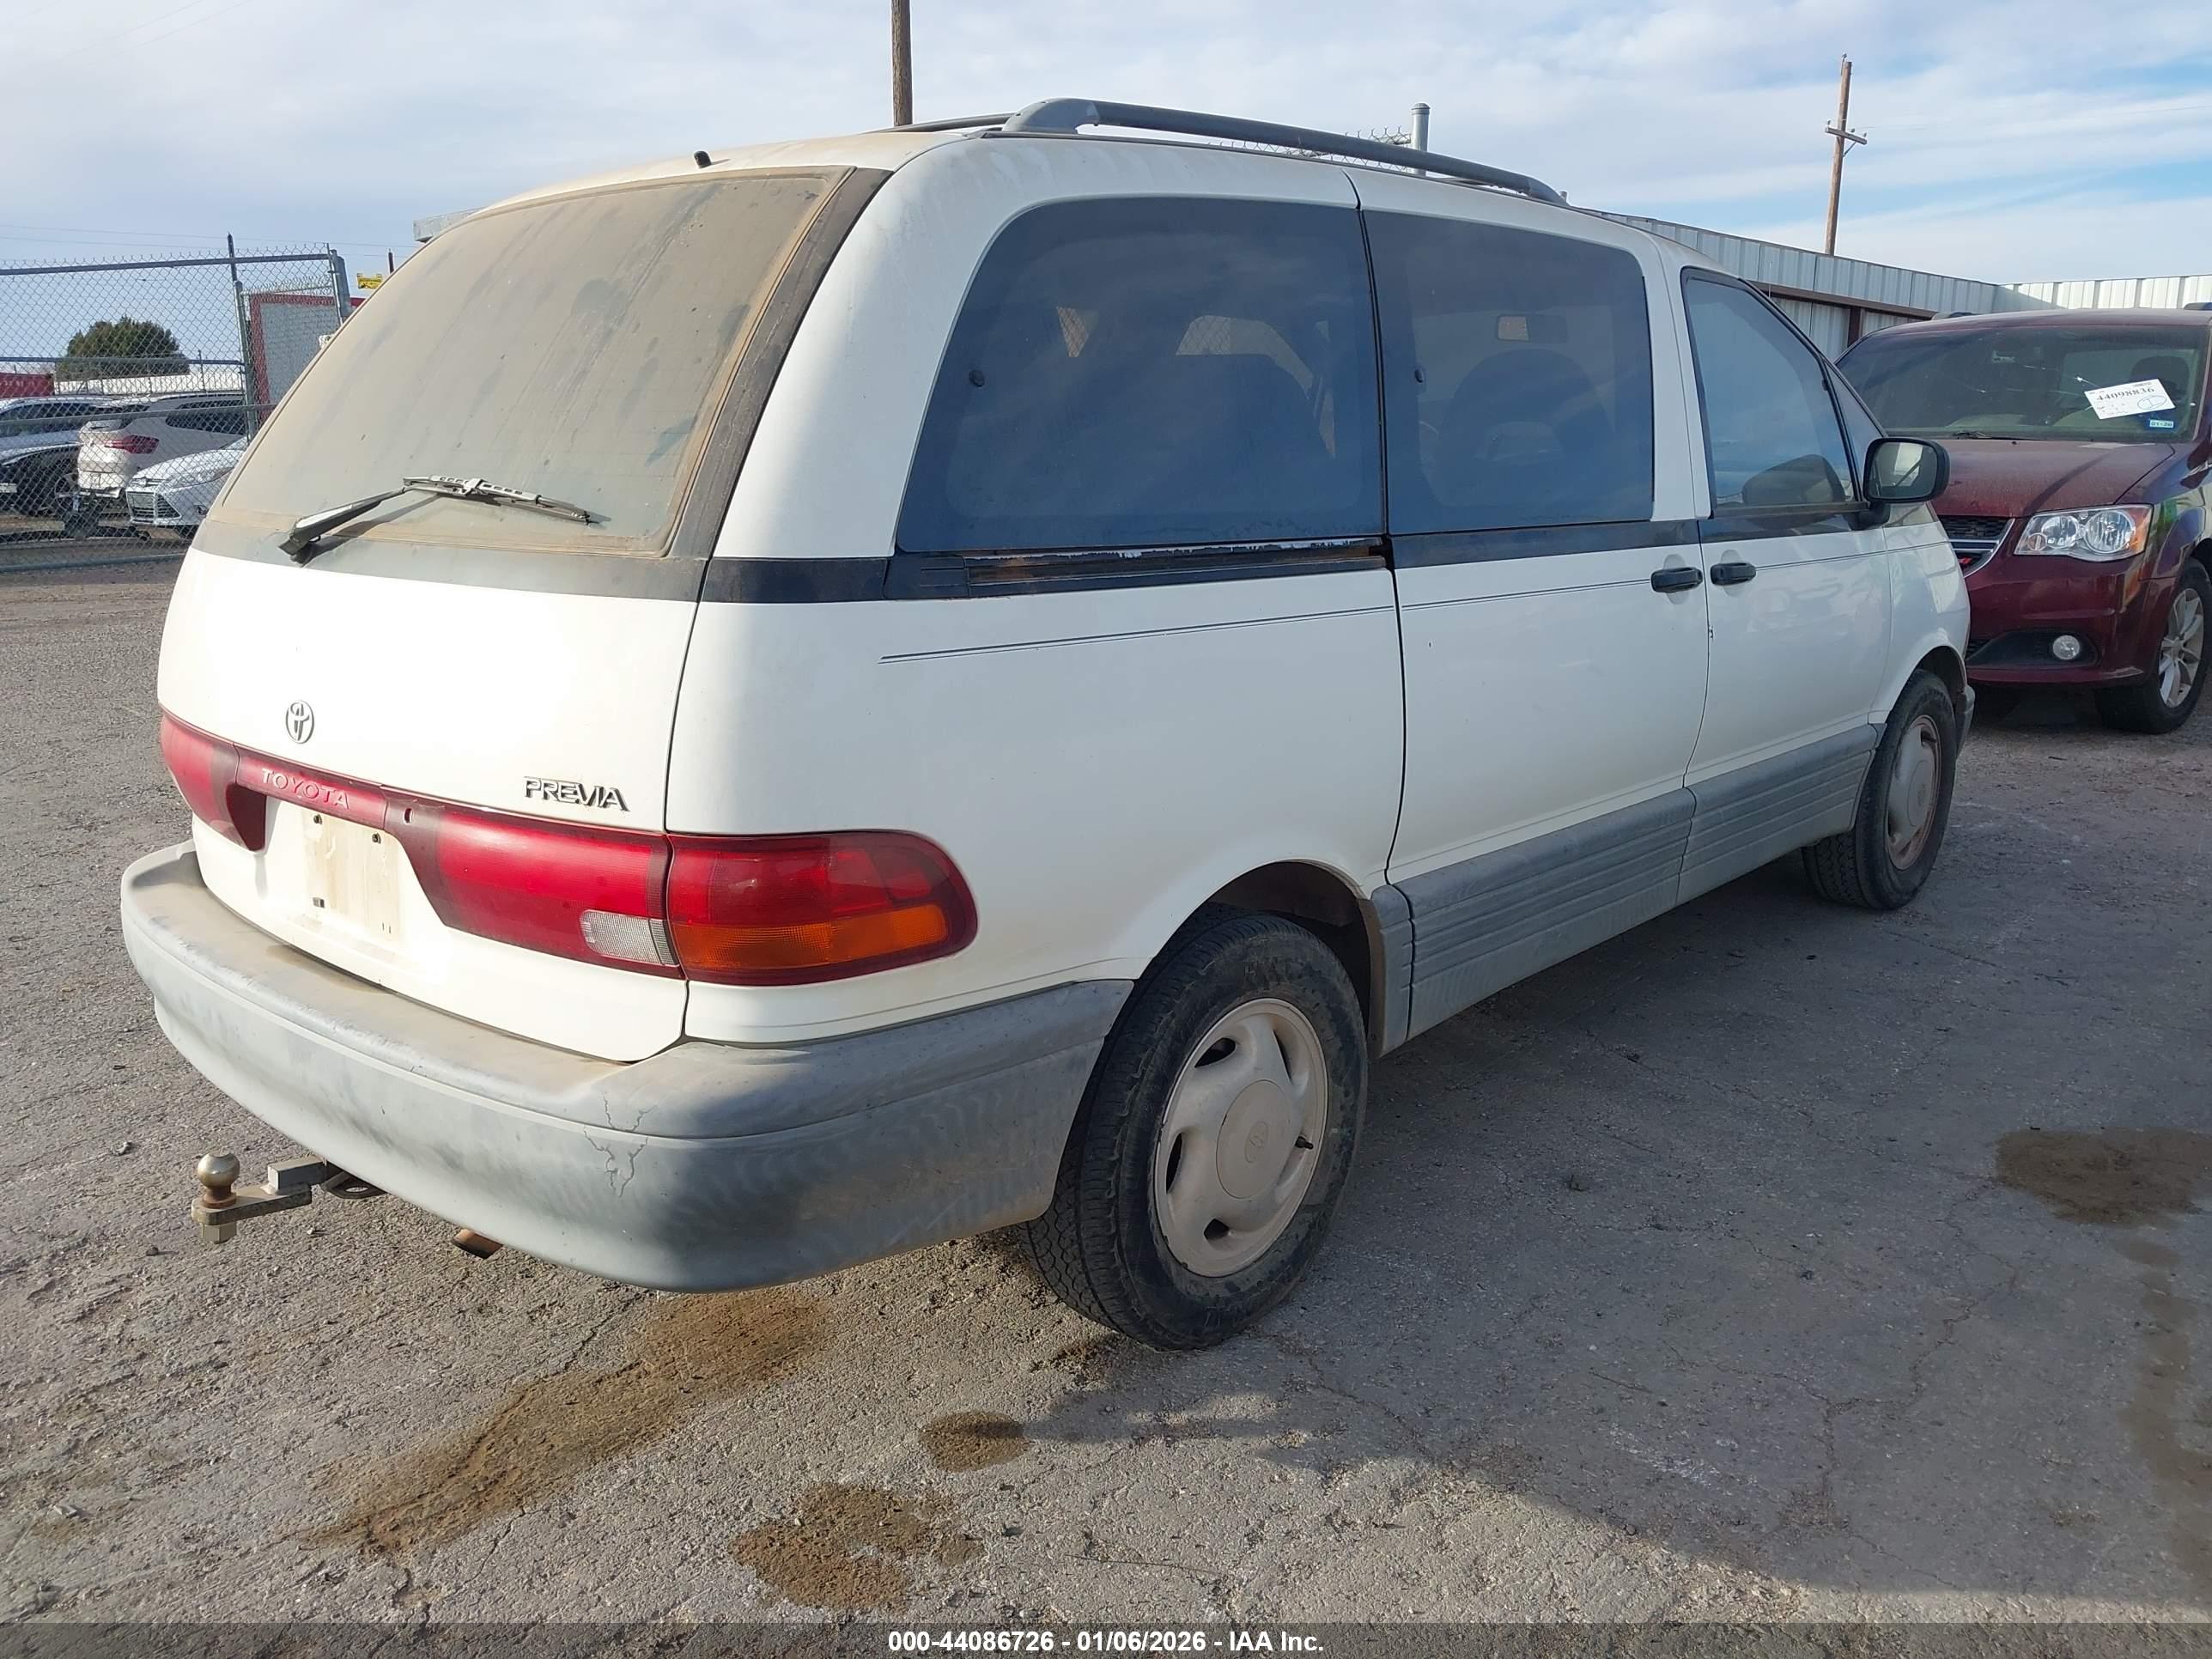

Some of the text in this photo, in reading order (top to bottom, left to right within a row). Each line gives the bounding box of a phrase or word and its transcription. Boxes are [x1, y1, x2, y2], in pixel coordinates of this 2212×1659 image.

[2098, 387, 2154, 400] 44098836
[262, 768, 349, 809] TOYOTA
[525, 777, 630, 811] PREVIA
